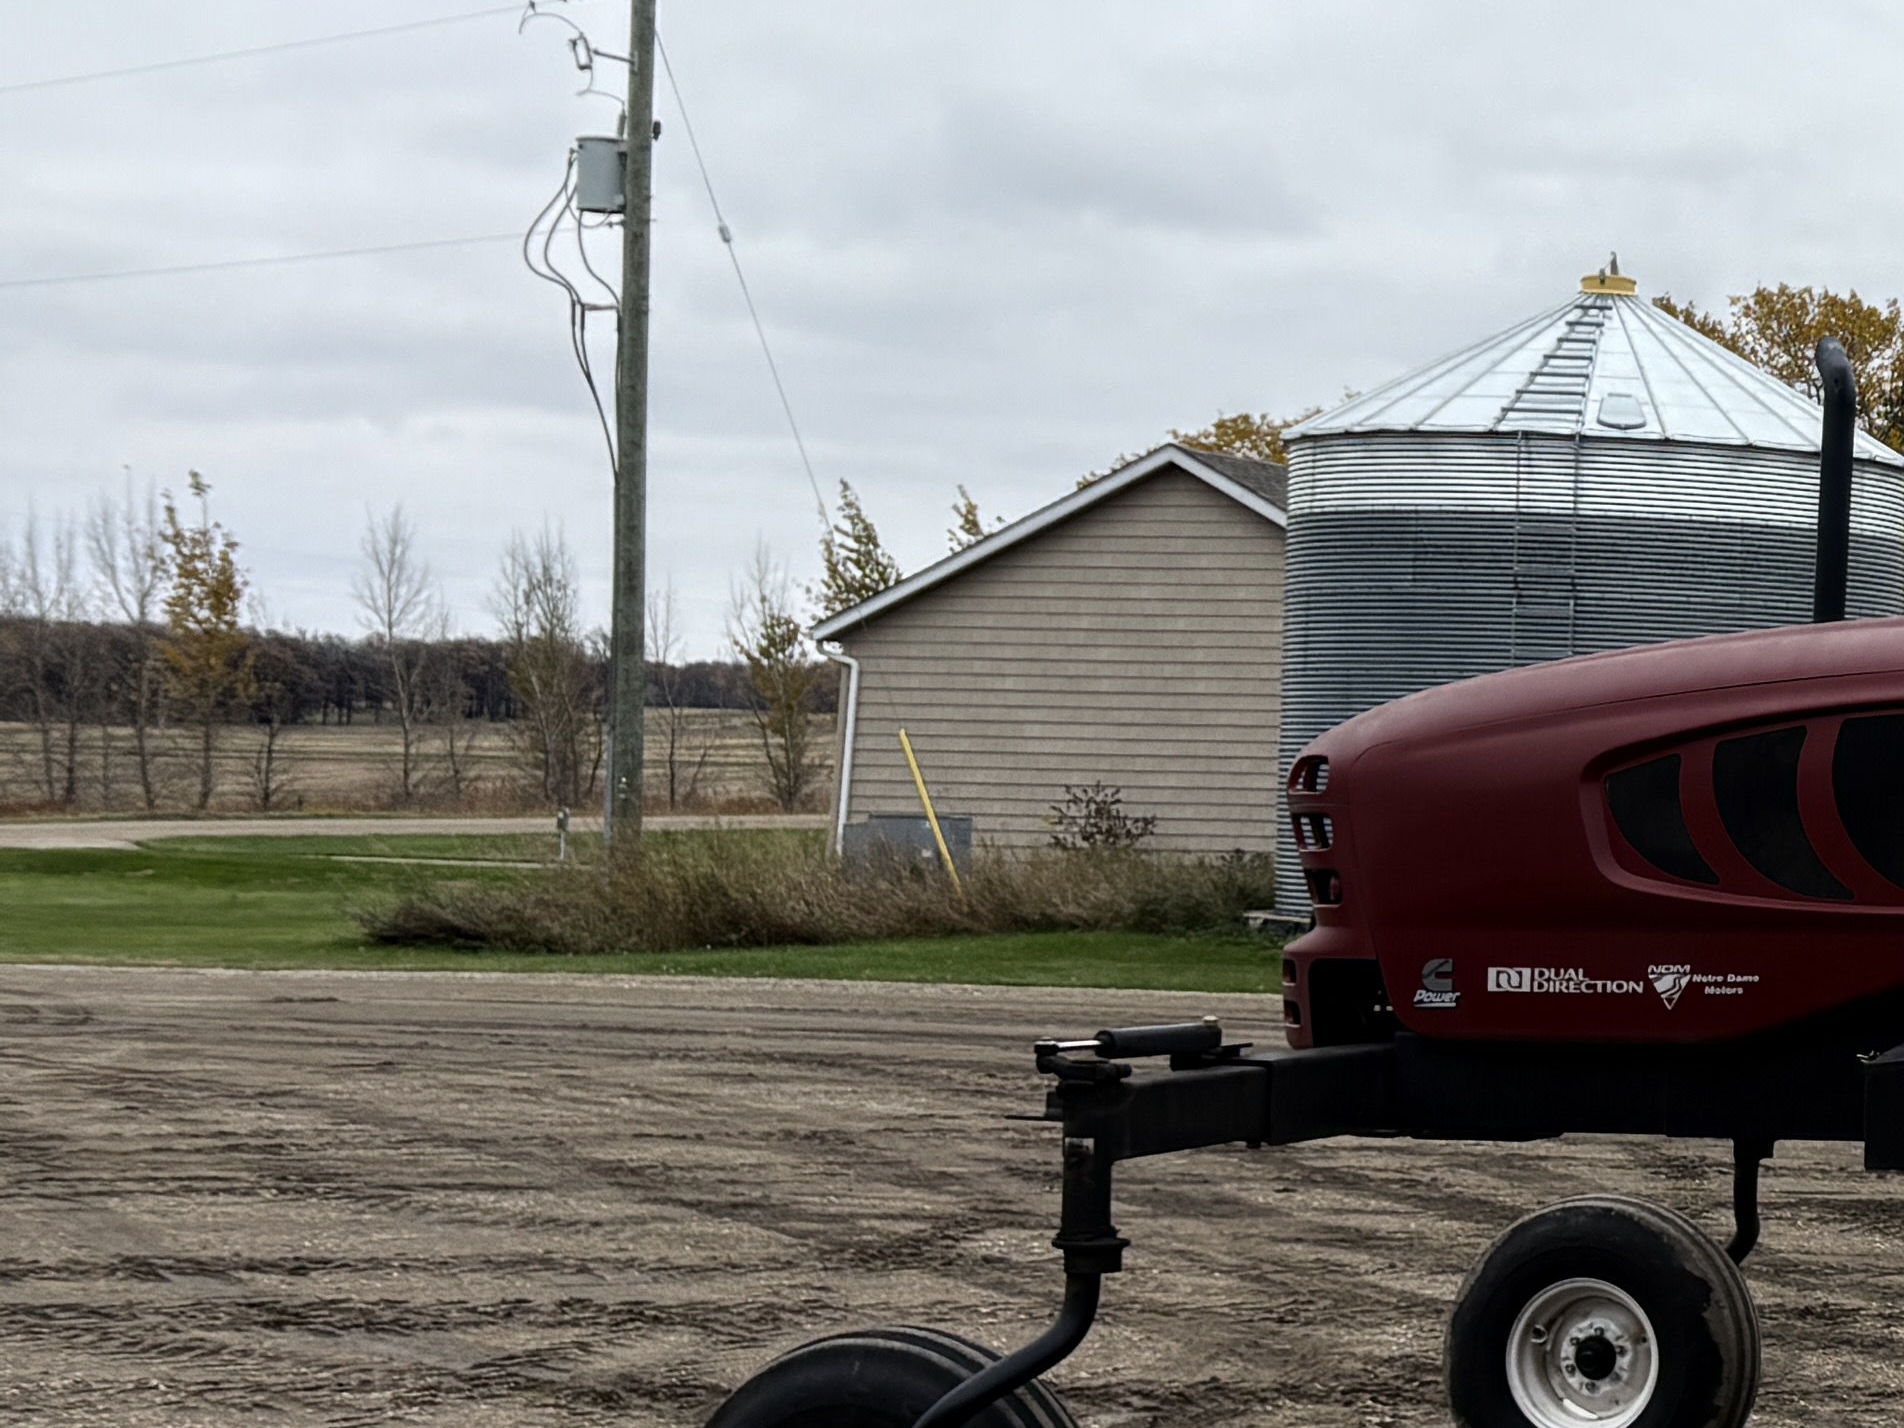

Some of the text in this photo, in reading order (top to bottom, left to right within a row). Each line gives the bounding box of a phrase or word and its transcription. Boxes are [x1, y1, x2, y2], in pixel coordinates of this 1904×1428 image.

[1533, 967, 1591, 981] DUAL
[1532, 979, 1645, 994] DIRECTION
[1412, 988, 1462, 1003] Power
